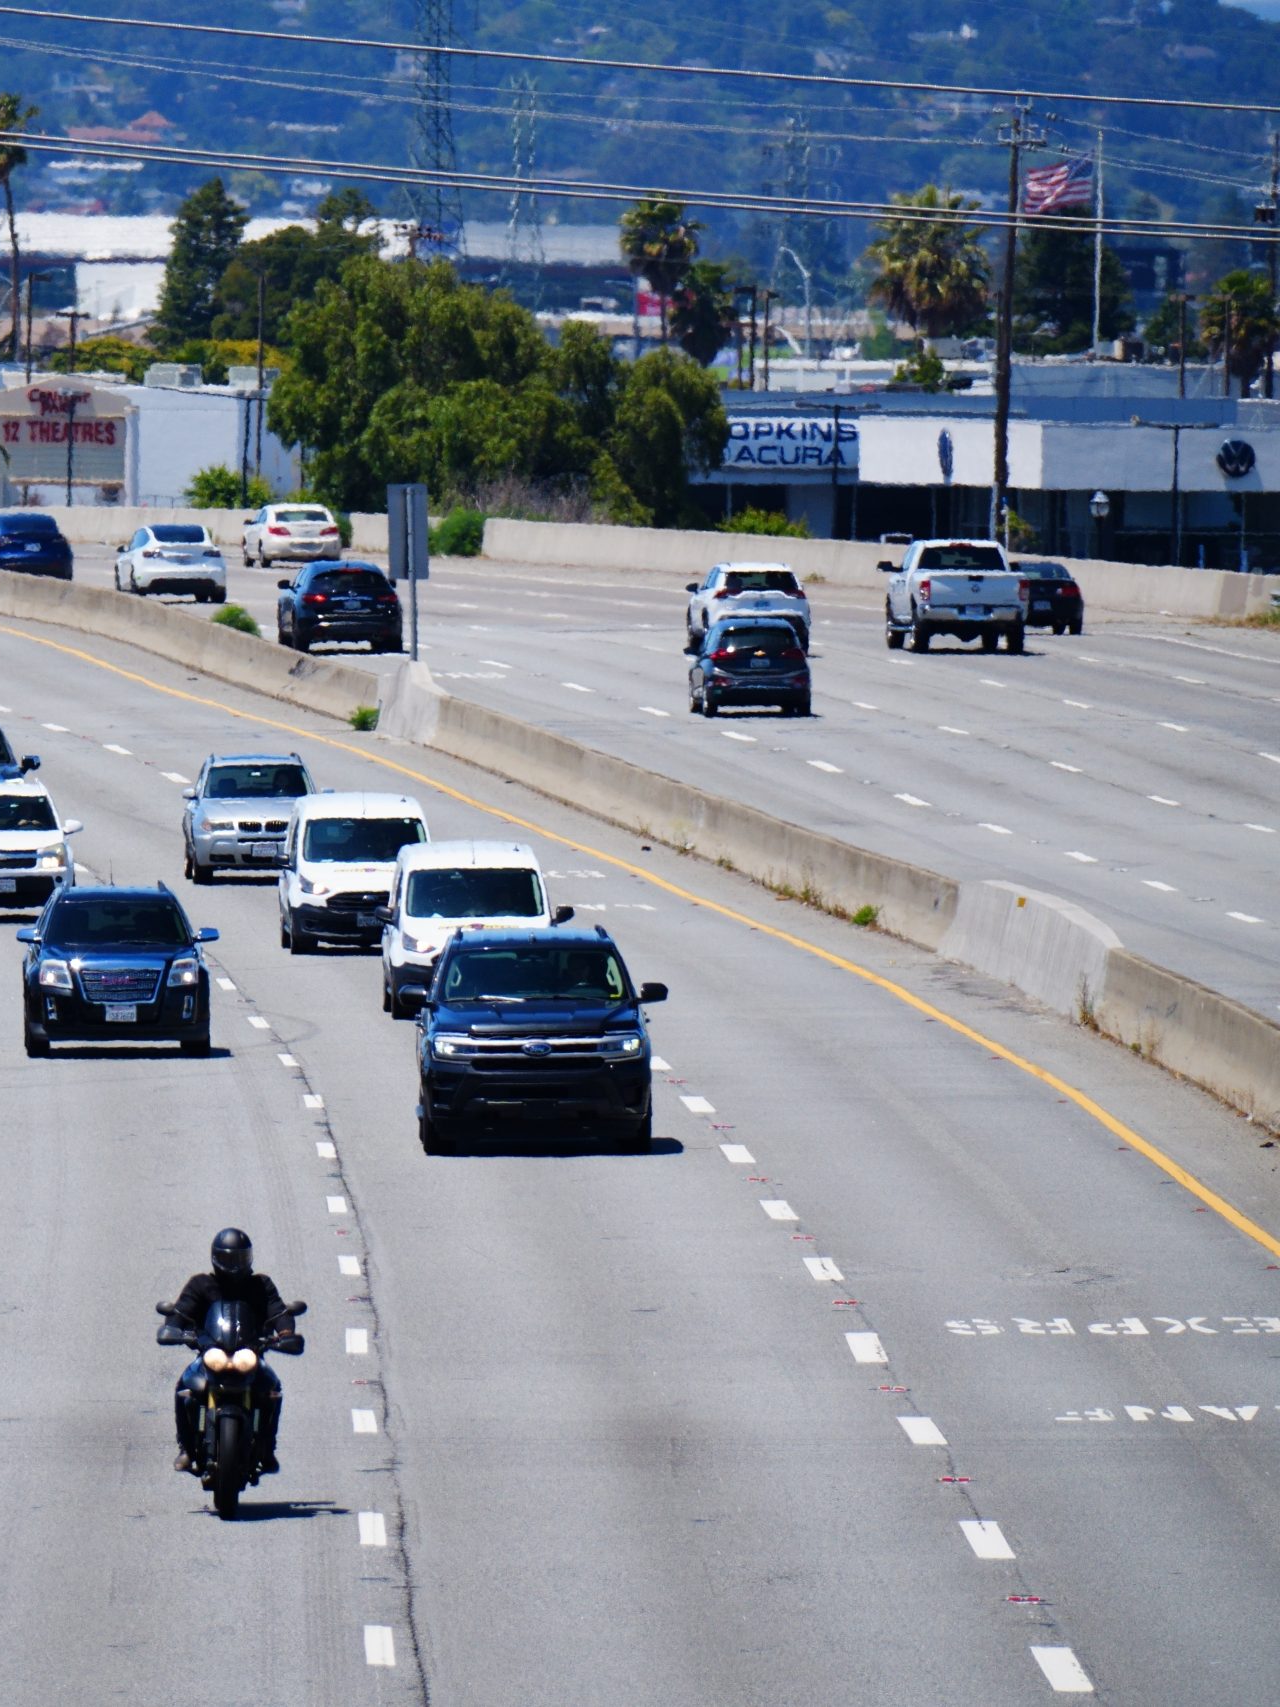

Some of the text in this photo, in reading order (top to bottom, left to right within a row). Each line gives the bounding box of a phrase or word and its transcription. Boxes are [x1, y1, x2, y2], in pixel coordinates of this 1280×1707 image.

[2, 420, 117, 446] 12 THEATRES
[728, 421, 858, 442] OPKINS
[734, 445, 846, 466] ACURA
[1053, 1404, 1280, 1423] ANE
